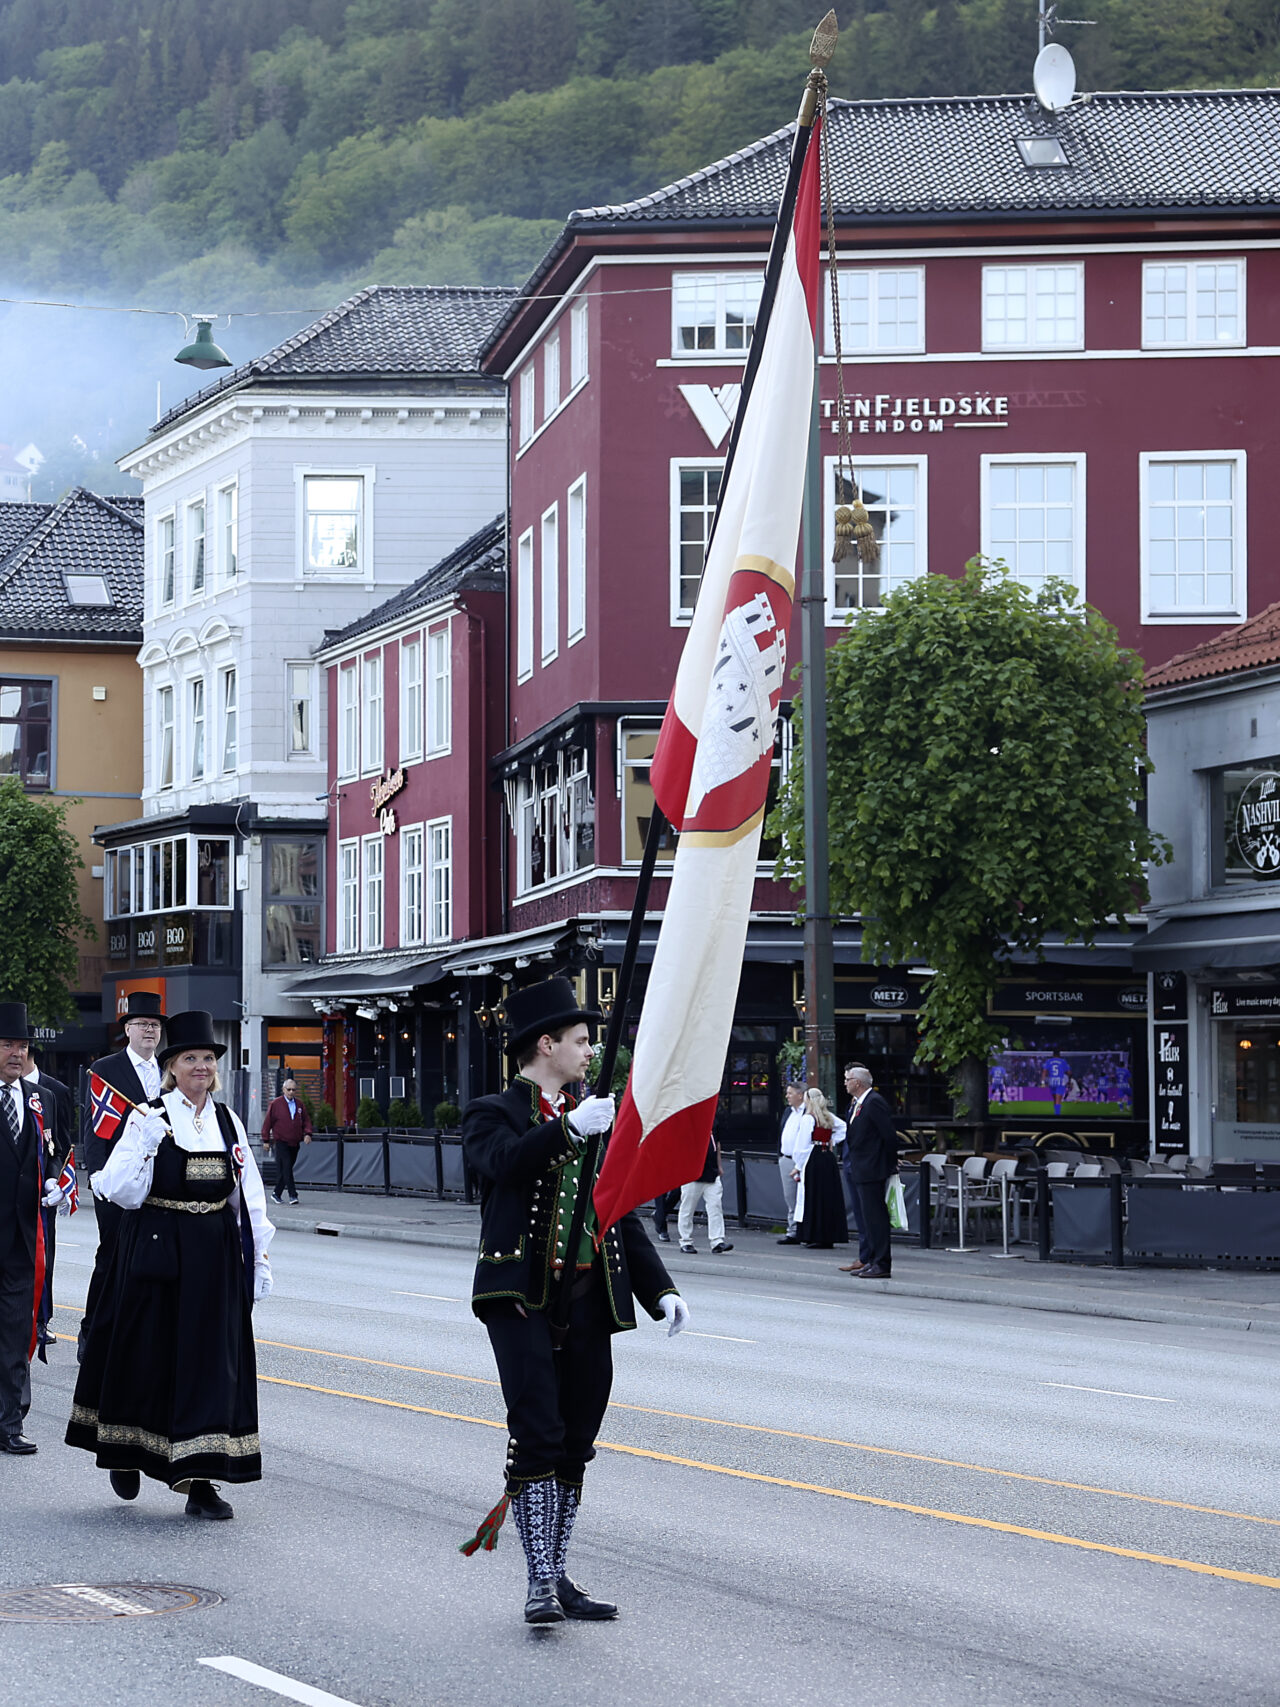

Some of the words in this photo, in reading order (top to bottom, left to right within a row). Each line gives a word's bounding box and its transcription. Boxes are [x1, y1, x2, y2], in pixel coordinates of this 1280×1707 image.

[831, 418, 945, 434] EIENDOM
[137, 930, 155, 948] BGO
[166, 927, 185, 945] BGO
[873, 991, 905, 1001] METZ
[1025, 991, 1083, 1001] SPORTSBAR
[1121, 993, 1148, 1004] MET
[1158, 1031, 1180, 1062] FELIX
[1052, 1064, 1059, 1076] 5
